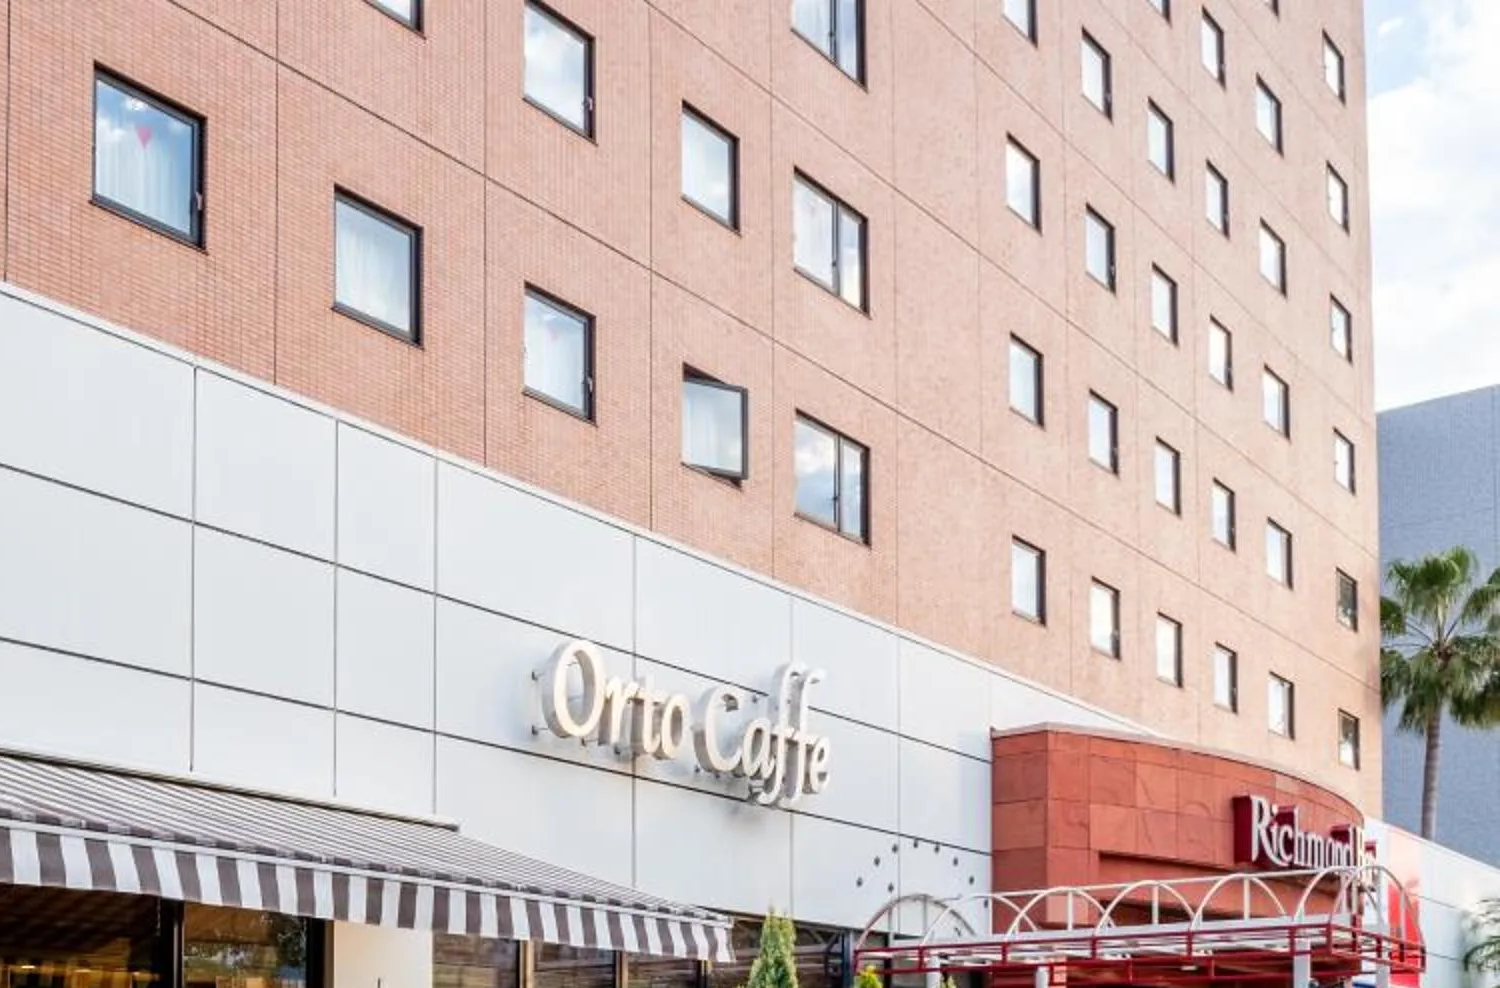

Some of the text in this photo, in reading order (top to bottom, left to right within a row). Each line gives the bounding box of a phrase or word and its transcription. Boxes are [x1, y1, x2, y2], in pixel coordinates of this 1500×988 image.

[545, 640, 831, 804] Orto Caffe
[1250, 795, 1354, 870] Richmond
